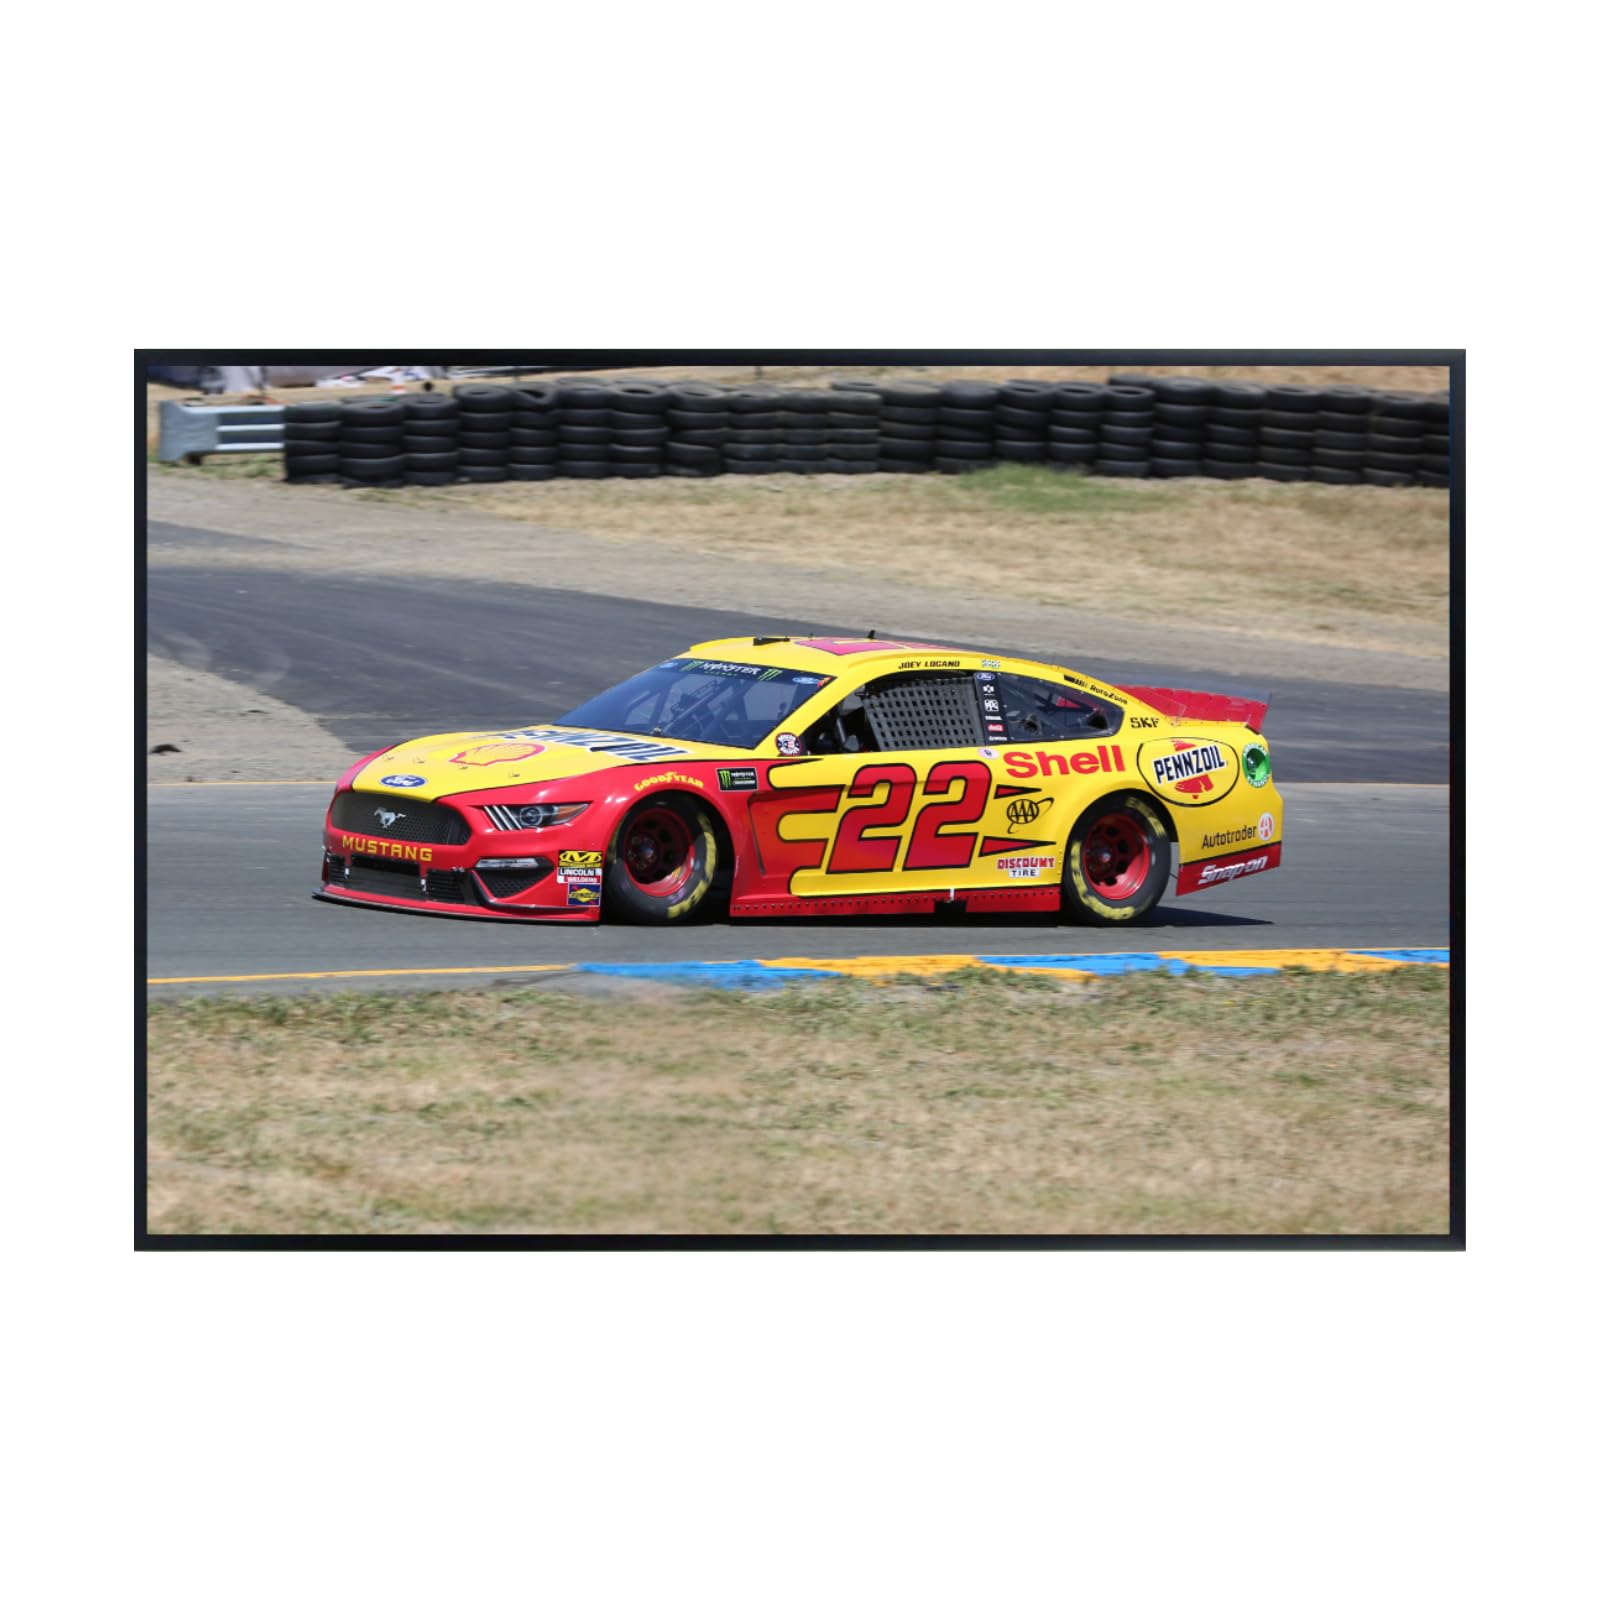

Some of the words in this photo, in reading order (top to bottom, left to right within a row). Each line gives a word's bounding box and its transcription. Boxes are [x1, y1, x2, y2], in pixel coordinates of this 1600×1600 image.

[898, 661, 921, 669] JOEY
[1130, 716, 1160, 729] SKF
[1002, 744, 1126, 779] Shell
[1153, 745, 1226, 784] PENNZOIL
[634, 771, 704, 792] GOODYEAR
[825, 760, 992, 875] 22
[1009, 802, 1036, 822] AAA
[1201, 825, 1257, 850] Autotrader
[342, 835, 433, 862] MUSTANG
[560, 868, 595, 876] LINCOLN
[997, 857, 1055, 869] DISCOUNT
